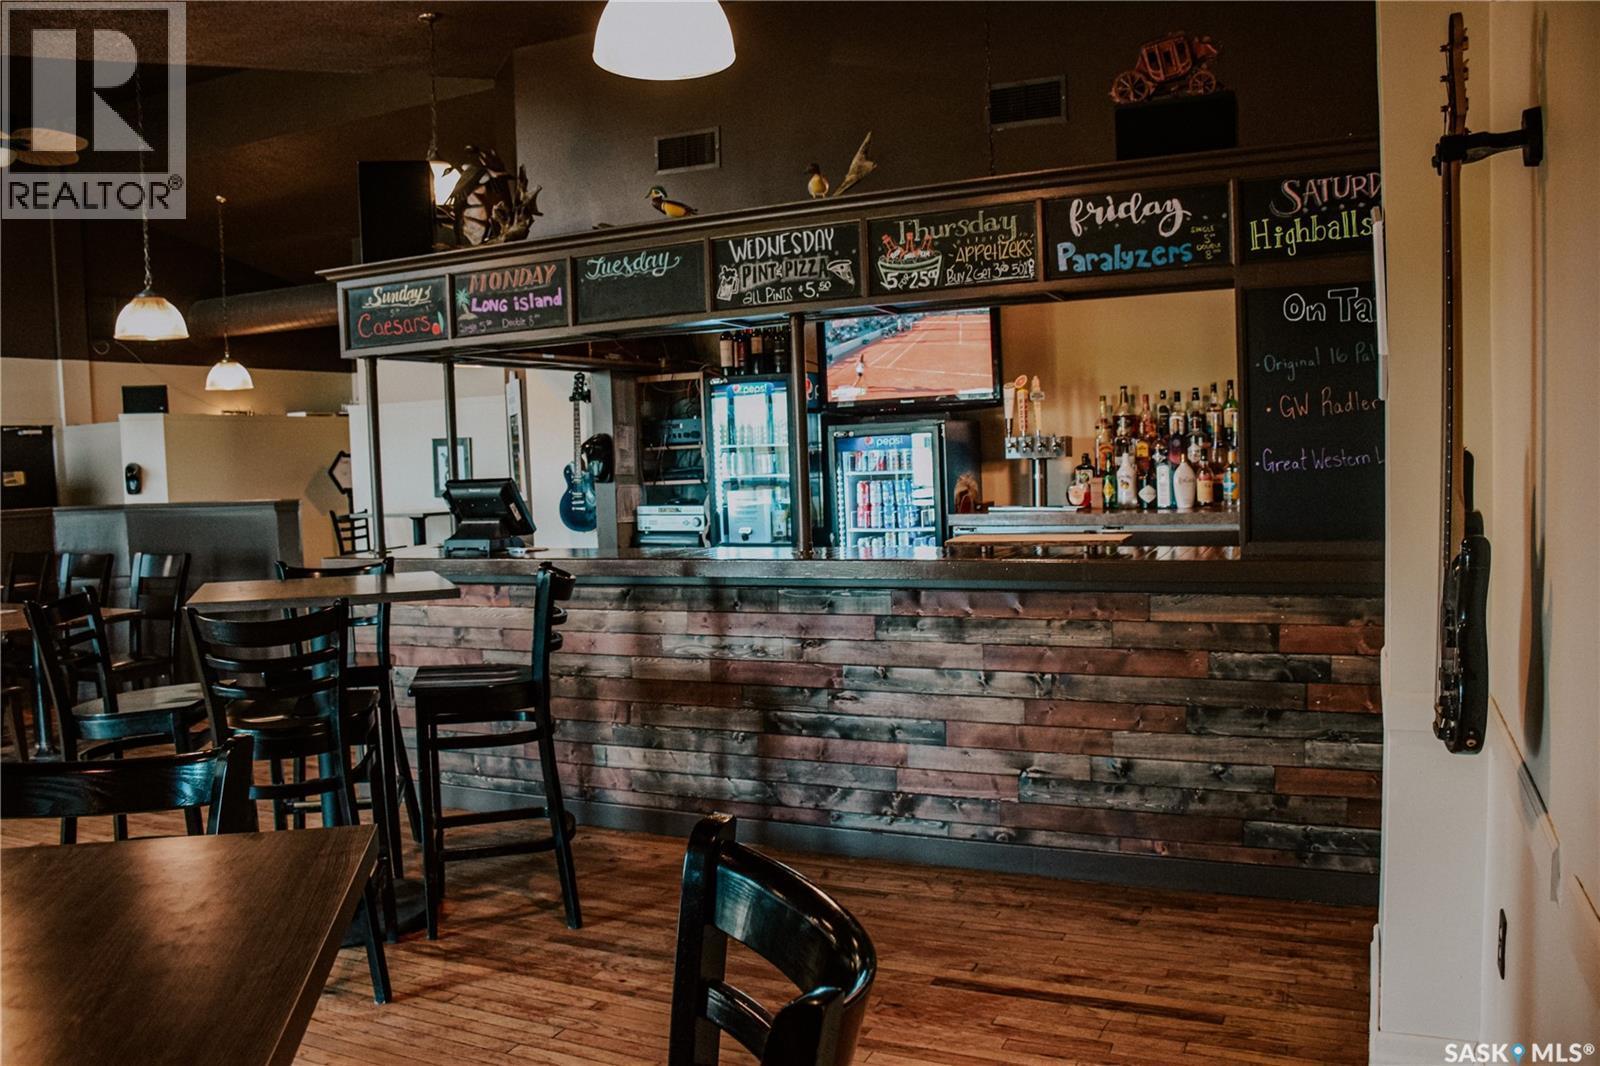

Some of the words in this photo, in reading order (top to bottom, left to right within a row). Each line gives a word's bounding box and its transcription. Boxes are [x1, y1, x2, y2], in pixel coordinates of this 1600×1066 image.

[894, 210, 1018, 244] Thursday
[1250, 210, 1372, 256] Highballs
[728, 227, 834, 263] WEDNESDAY
[1057, 242, 1192, 272] Paralyzers
[468, 264, 556, 294] MONDAY
[585, 250, 681, 279] Tuesday
[362, 284, 432, 308] Sunday
[471, 297, 508, 312] LONG
[1283, 293, 1326, 322] On
[1328, 287, 1377, 322] Ta
[358, 312, 431, 338] Caesars
[1264, 347, 1320, 381] Original
[1321, 386, 1381, 416] Radler
[876, 436, 903, 447] pepsi
[1262, 447, 1307, 472] Great
[1312, 448, 1371, 471] Western
